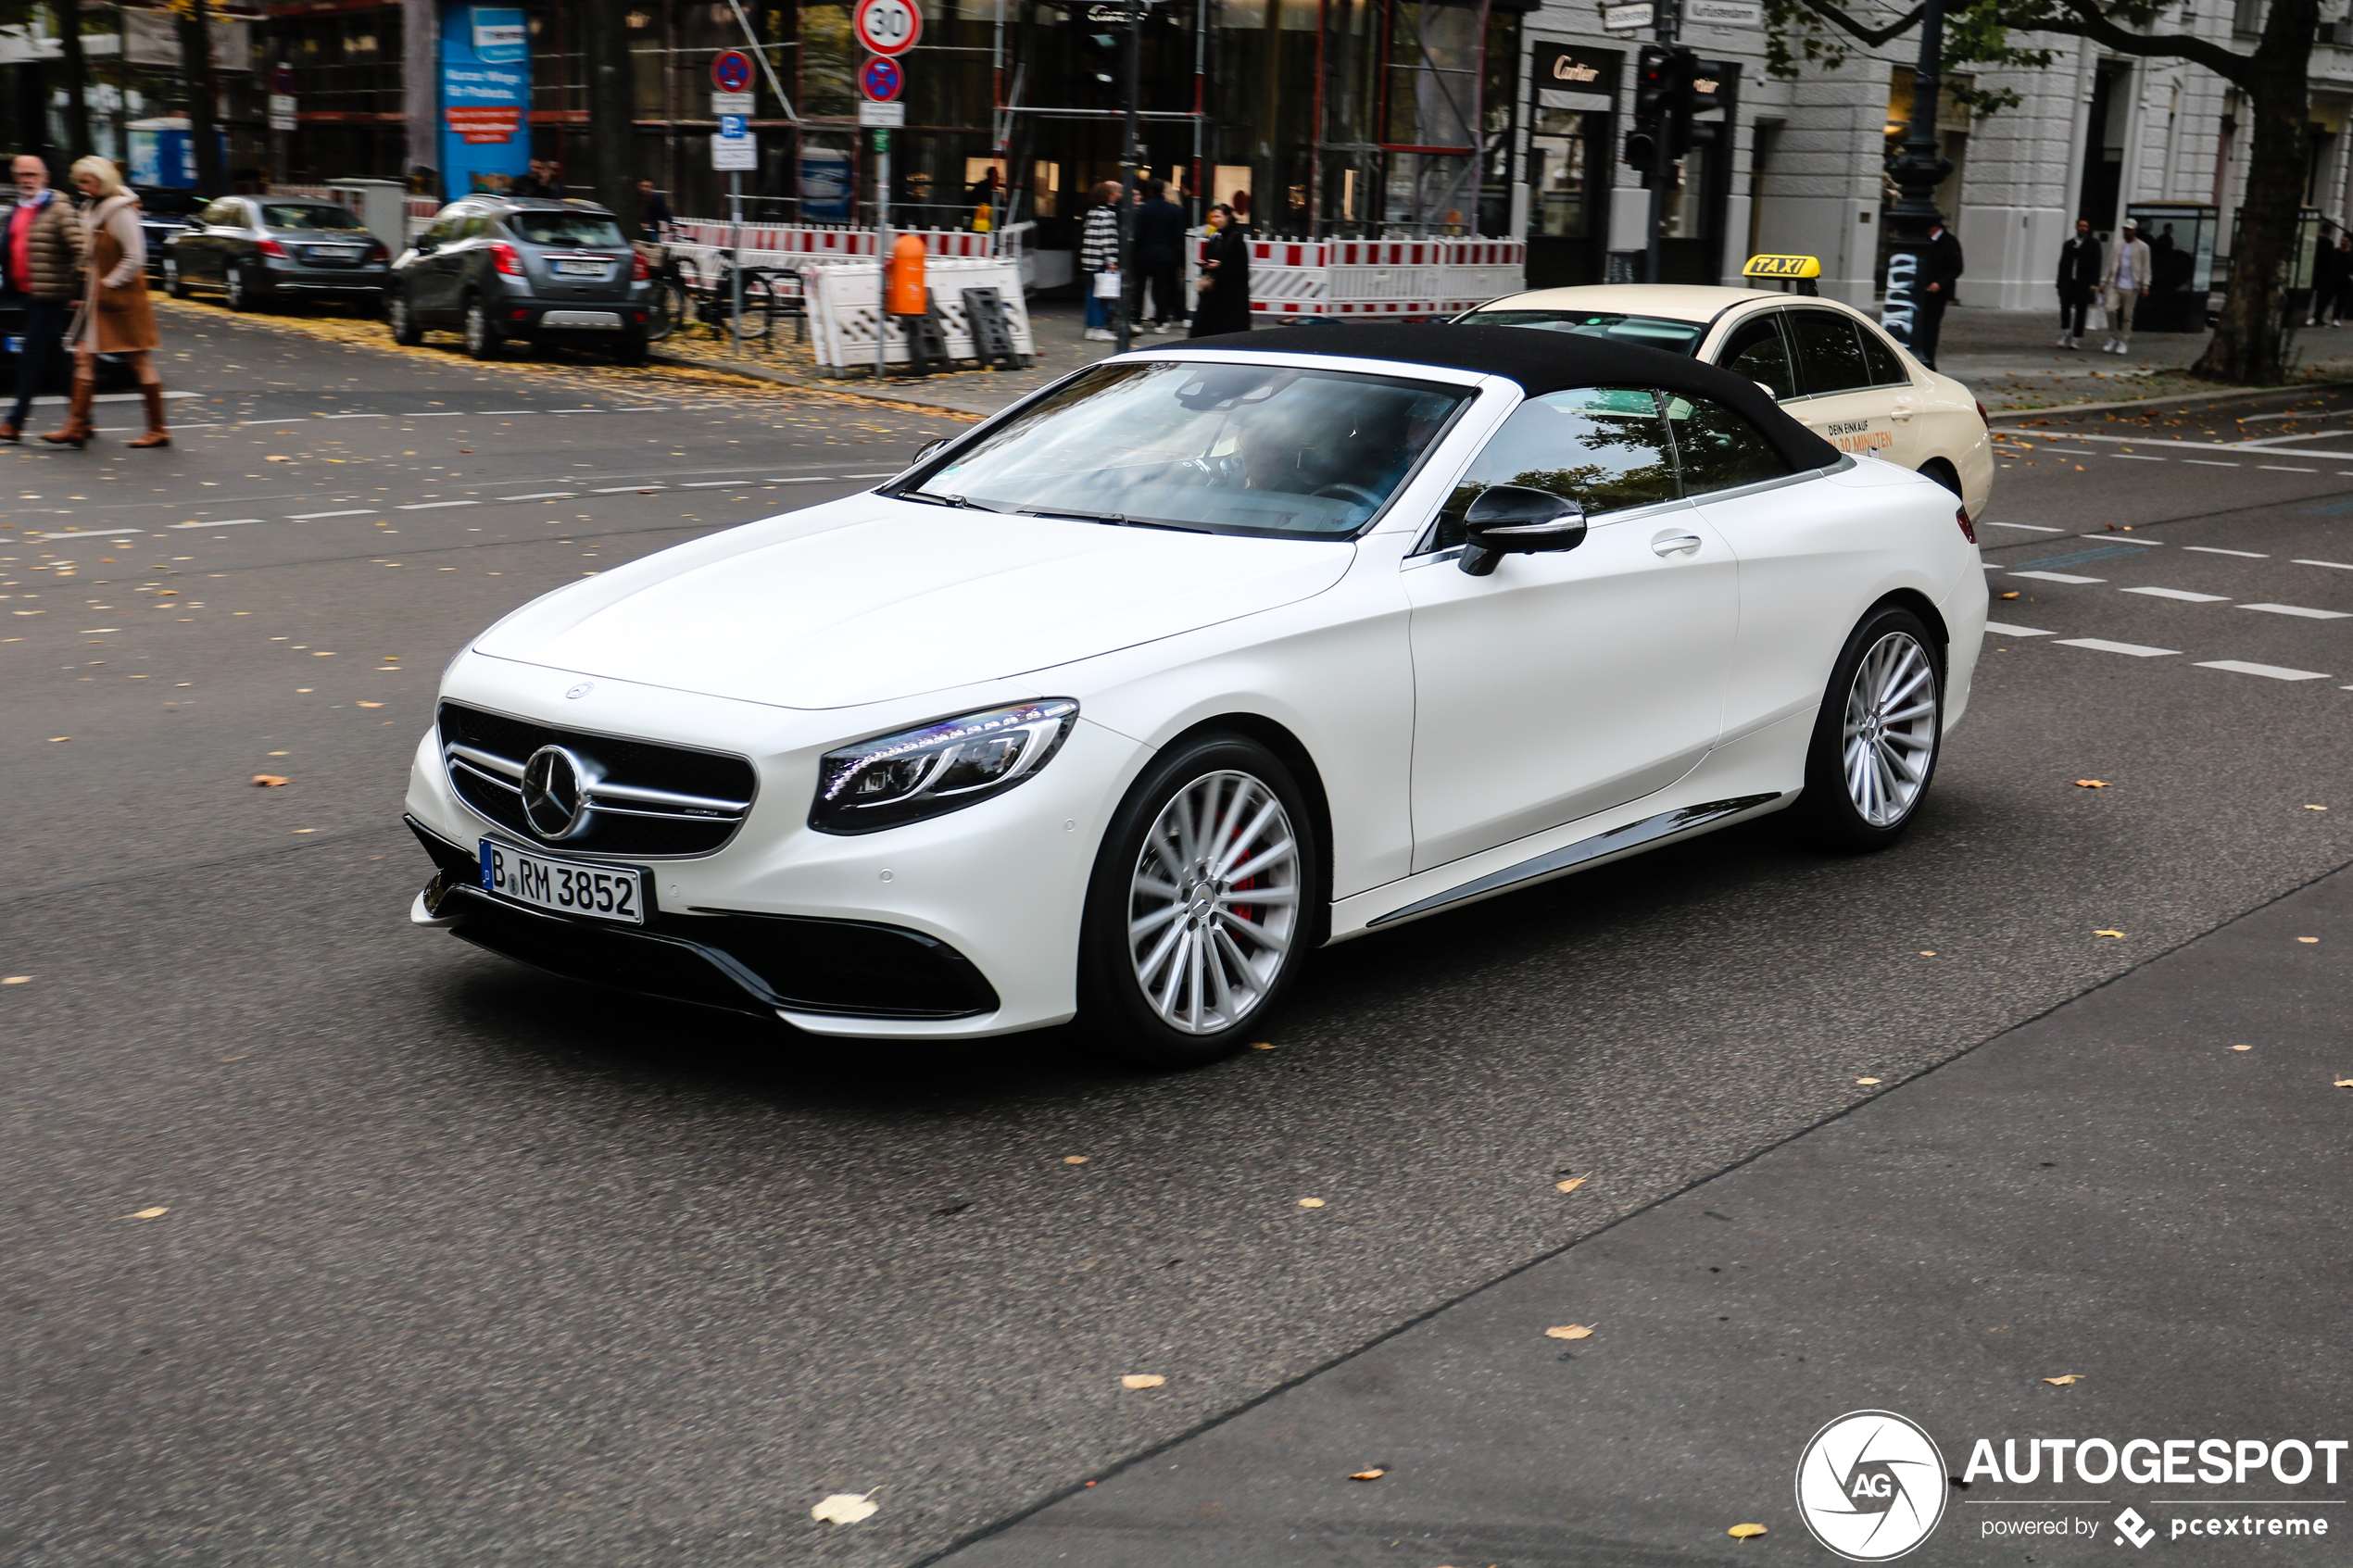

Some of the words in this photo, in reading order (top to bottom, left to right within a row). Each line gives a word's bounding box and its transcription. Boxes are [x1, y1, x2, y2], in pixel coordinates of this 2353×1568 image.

[868, 7, 907, 37] 30
[1692, 4, 1755, 19] Kurfürstendamm
[1554, 55, 1599, 82] Cartier
[1755, 257, 1805, 274] TAXI
[1829, 423, 1843, 436] DEIN
[1844, 420, 1869, 433] EINKAUF
[1839, 437, 1851, 453] 30
[1853, 431, 1893, 452] MINUTEN
[492, 849, 506, 887] B
[519, 859, 551, 903] RM
[557, 868, 635, 916] 3852
